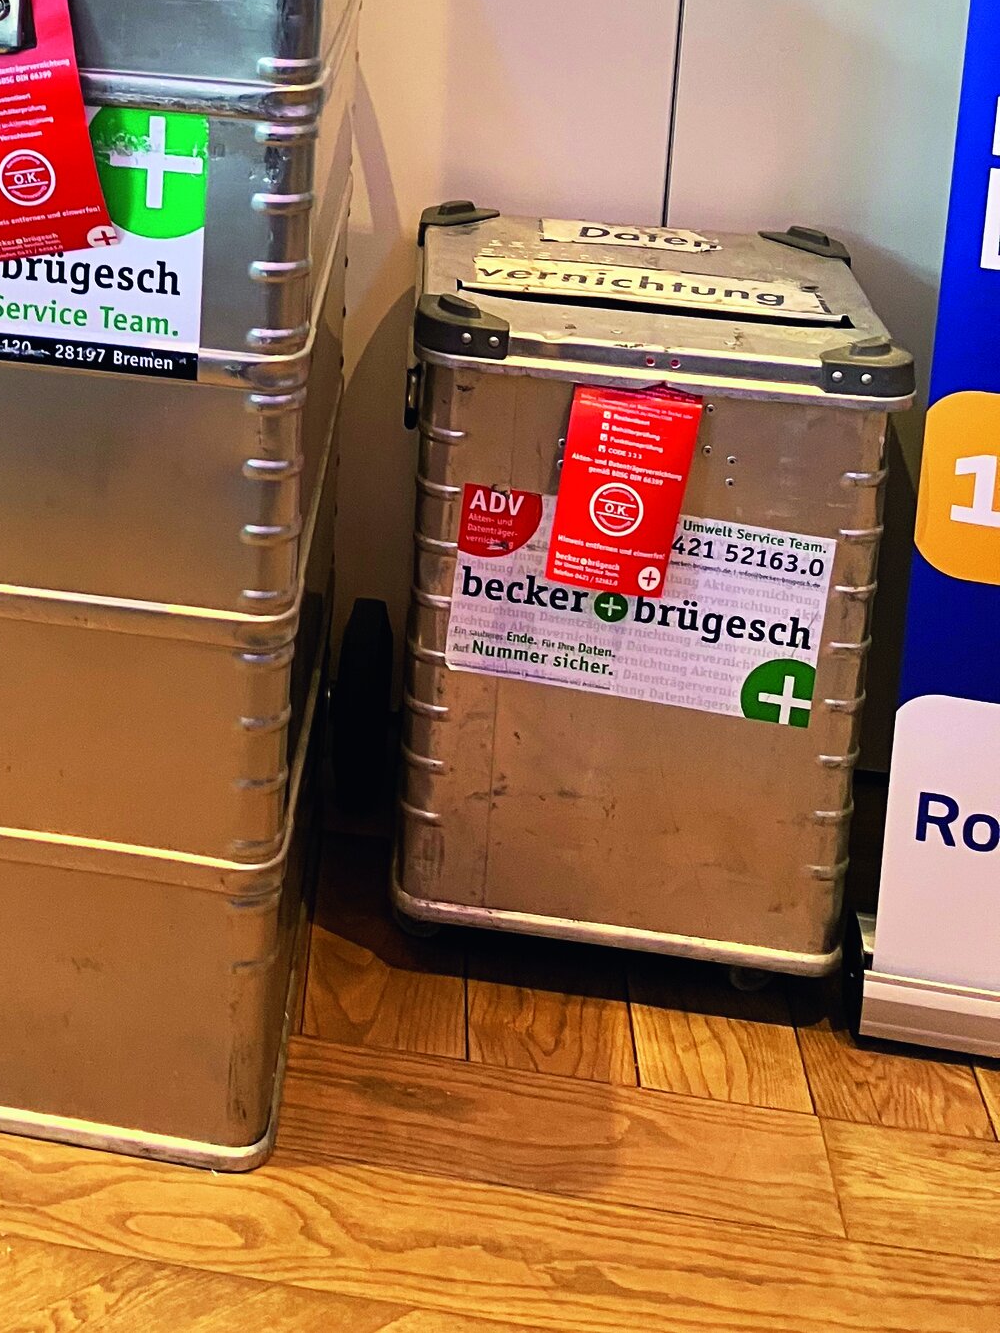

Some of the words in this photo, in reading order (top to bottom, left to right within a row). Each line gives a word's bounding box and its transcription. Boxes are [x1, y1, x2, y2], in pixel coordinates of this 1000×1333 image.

[14, 172, 40, 185] O.K.
[11, 214, 46, 225] entfernen
[1, 252, 181, 296] brügesch
[478, 266, 785, 306] vernichtung
[100, 306, 179, 337] Team.
[2, 337, 32, 352] 120
[55, 344, 106, 363] 28197
[113, 350, 173, 370] Bremen
[608, 448, 626, 457] CODE
[468, 513, 495, 523] Akten-
[469, 489, 525, 516] ADV
[604, 502, 629, 516] O.K.
[466, 535, 514, 549] vernichtg
[467, 523, 518, 538] Datenträger-
[683, 520, 733, 538] Umwelt
[737, 529, 785, 547] Service
[789, 537, 827, 554] Team.
[619, 548, 632, 556] und
[671, 536, 714, 559] 421
[724, 544, 825, 577] 52163.0
[462, 565, 589, 613] becker
[634, 596, 811, 650] brügesch
[454, 625, 467, 635] Ein
[506, 632, 537, 646] Ende.
[541, 639, 555, 649] Für
[557, 642, 575, 652] Ihre
[578, 643, 616, 658] Daten.
[453, 643, 469, 653] Auf
[472, 640, 548, 664] Nummer
[553, 654, 613, 676] sicher.
[916, 792, 1000, 852] Ro
